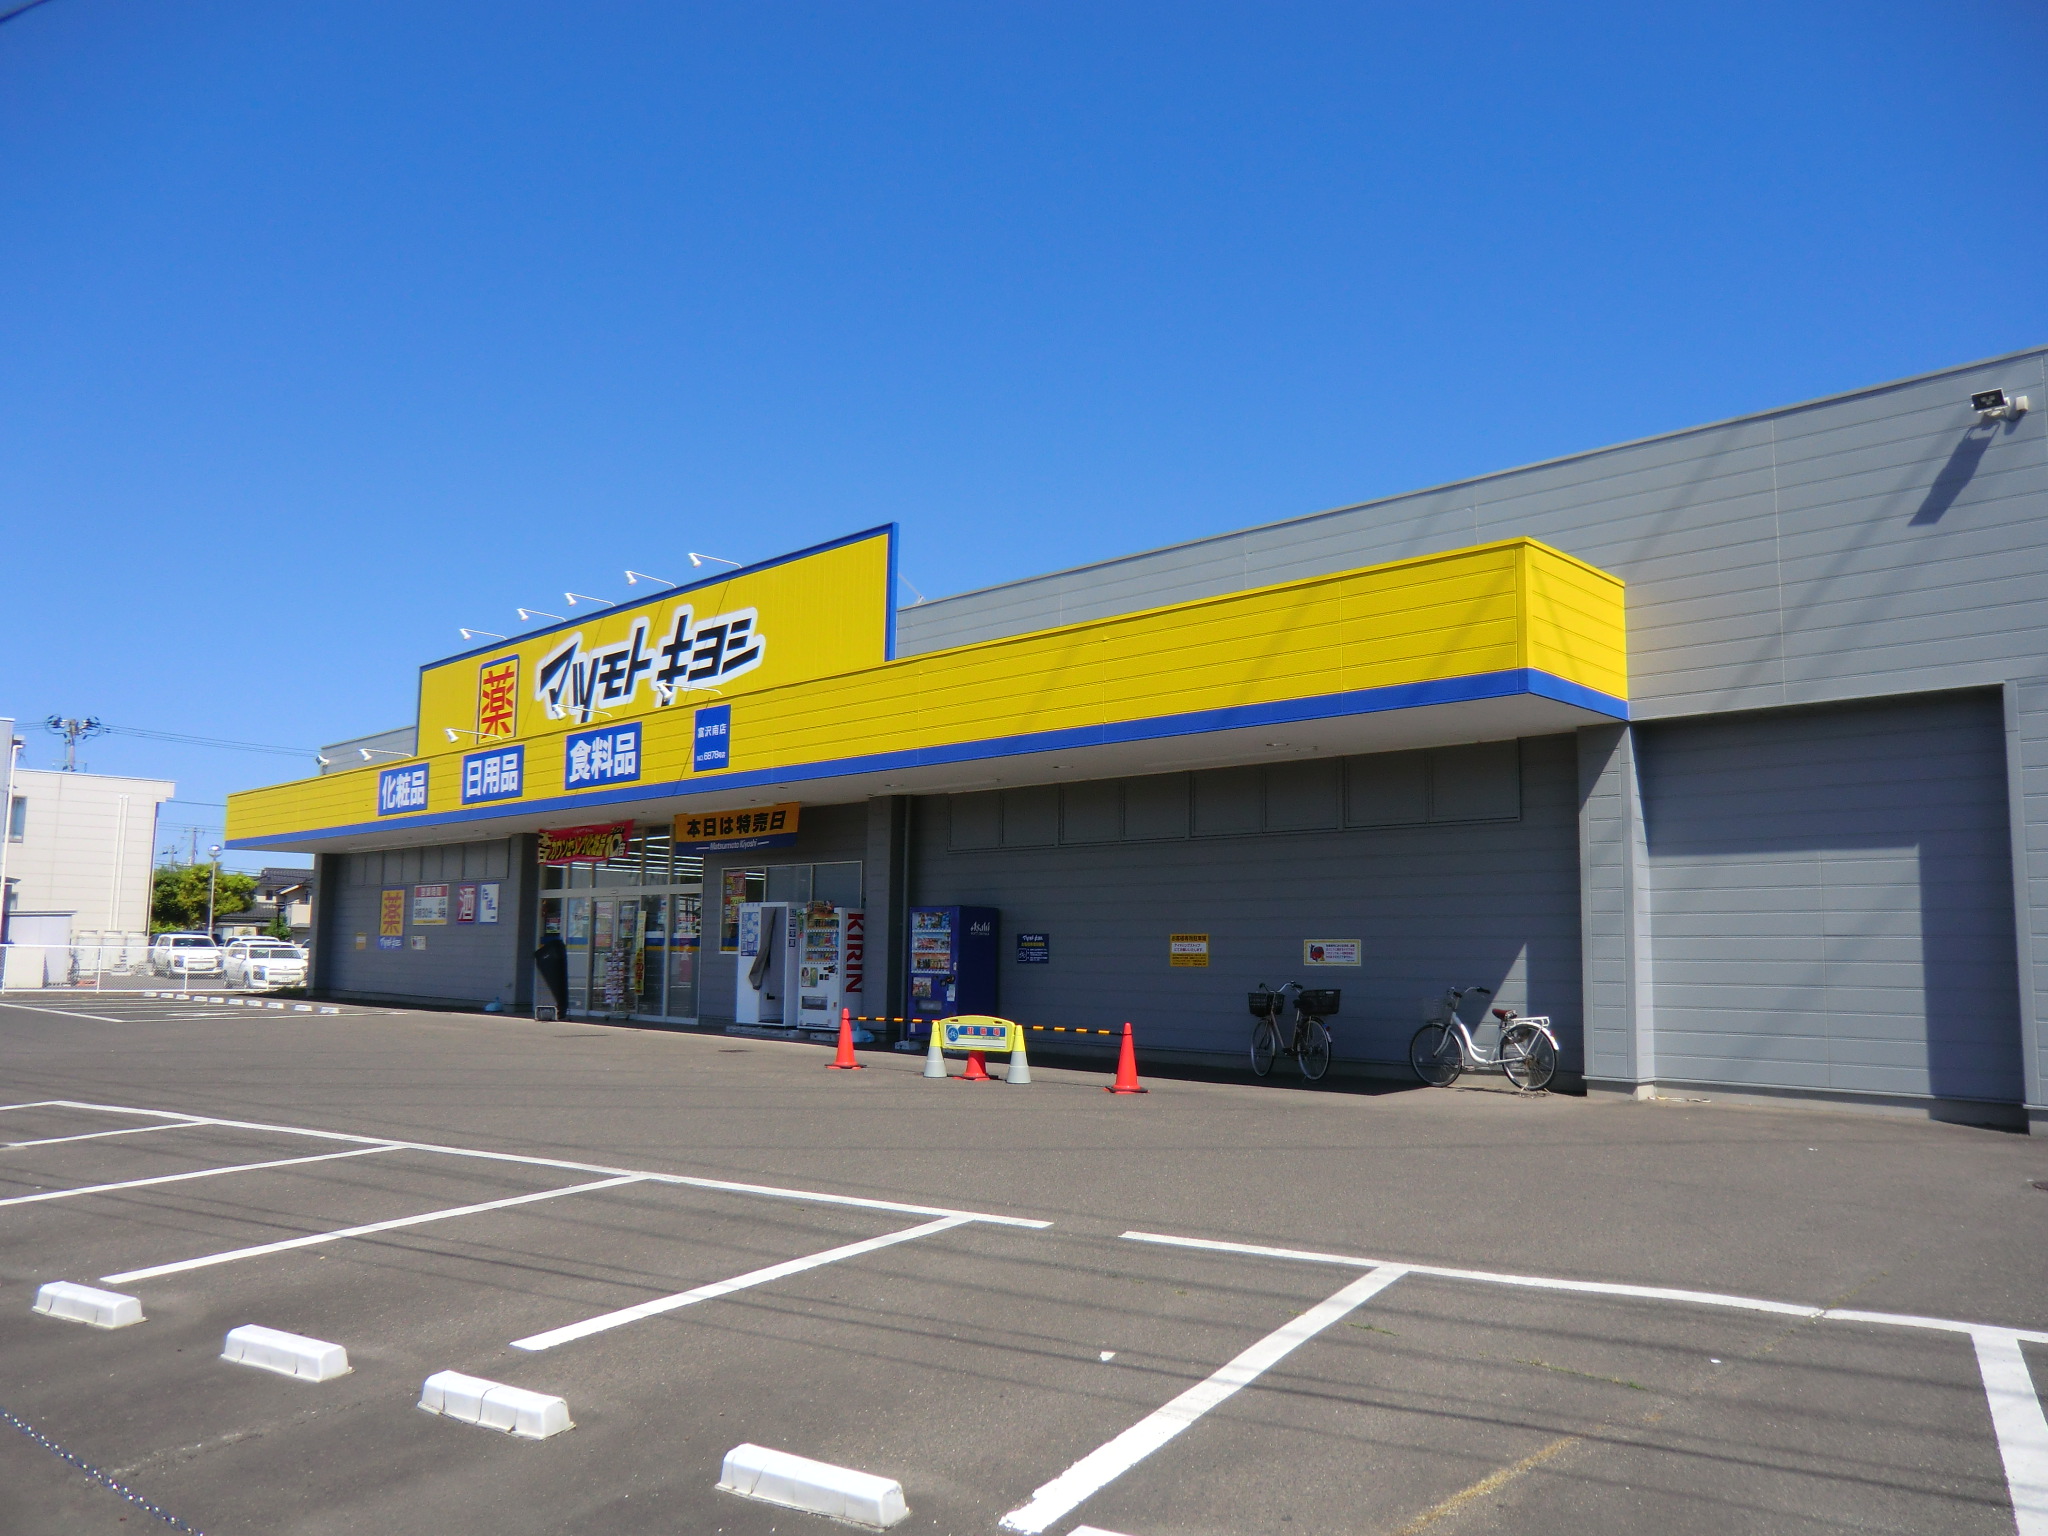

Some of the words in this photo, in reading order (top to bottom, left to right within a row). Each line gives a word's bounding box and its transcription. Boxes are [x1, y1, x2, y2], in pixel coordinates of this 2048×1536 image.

[536, 606, 764, 723] マツモトキヨシ
[480, 664, 515, 740] 薬
[697, 723, 727, 739] 富沢南店
[465, 753, 518, 799] 日用品
[568, 731, 637, 783] 食料品
[382, 770, 426, 811] 化粧品
[686, 810, 787, 838] 本日は特売日
[709, 841, 740, 851] Matsumoto
[740, 838, 758, 850] Kiyoshi
[382, 892, 402, 934] 薬
[458, 886, 476, 921] 酒
[970, 920, 990, 932] Asahi
[845, 912, 865, 993] KIRIN
